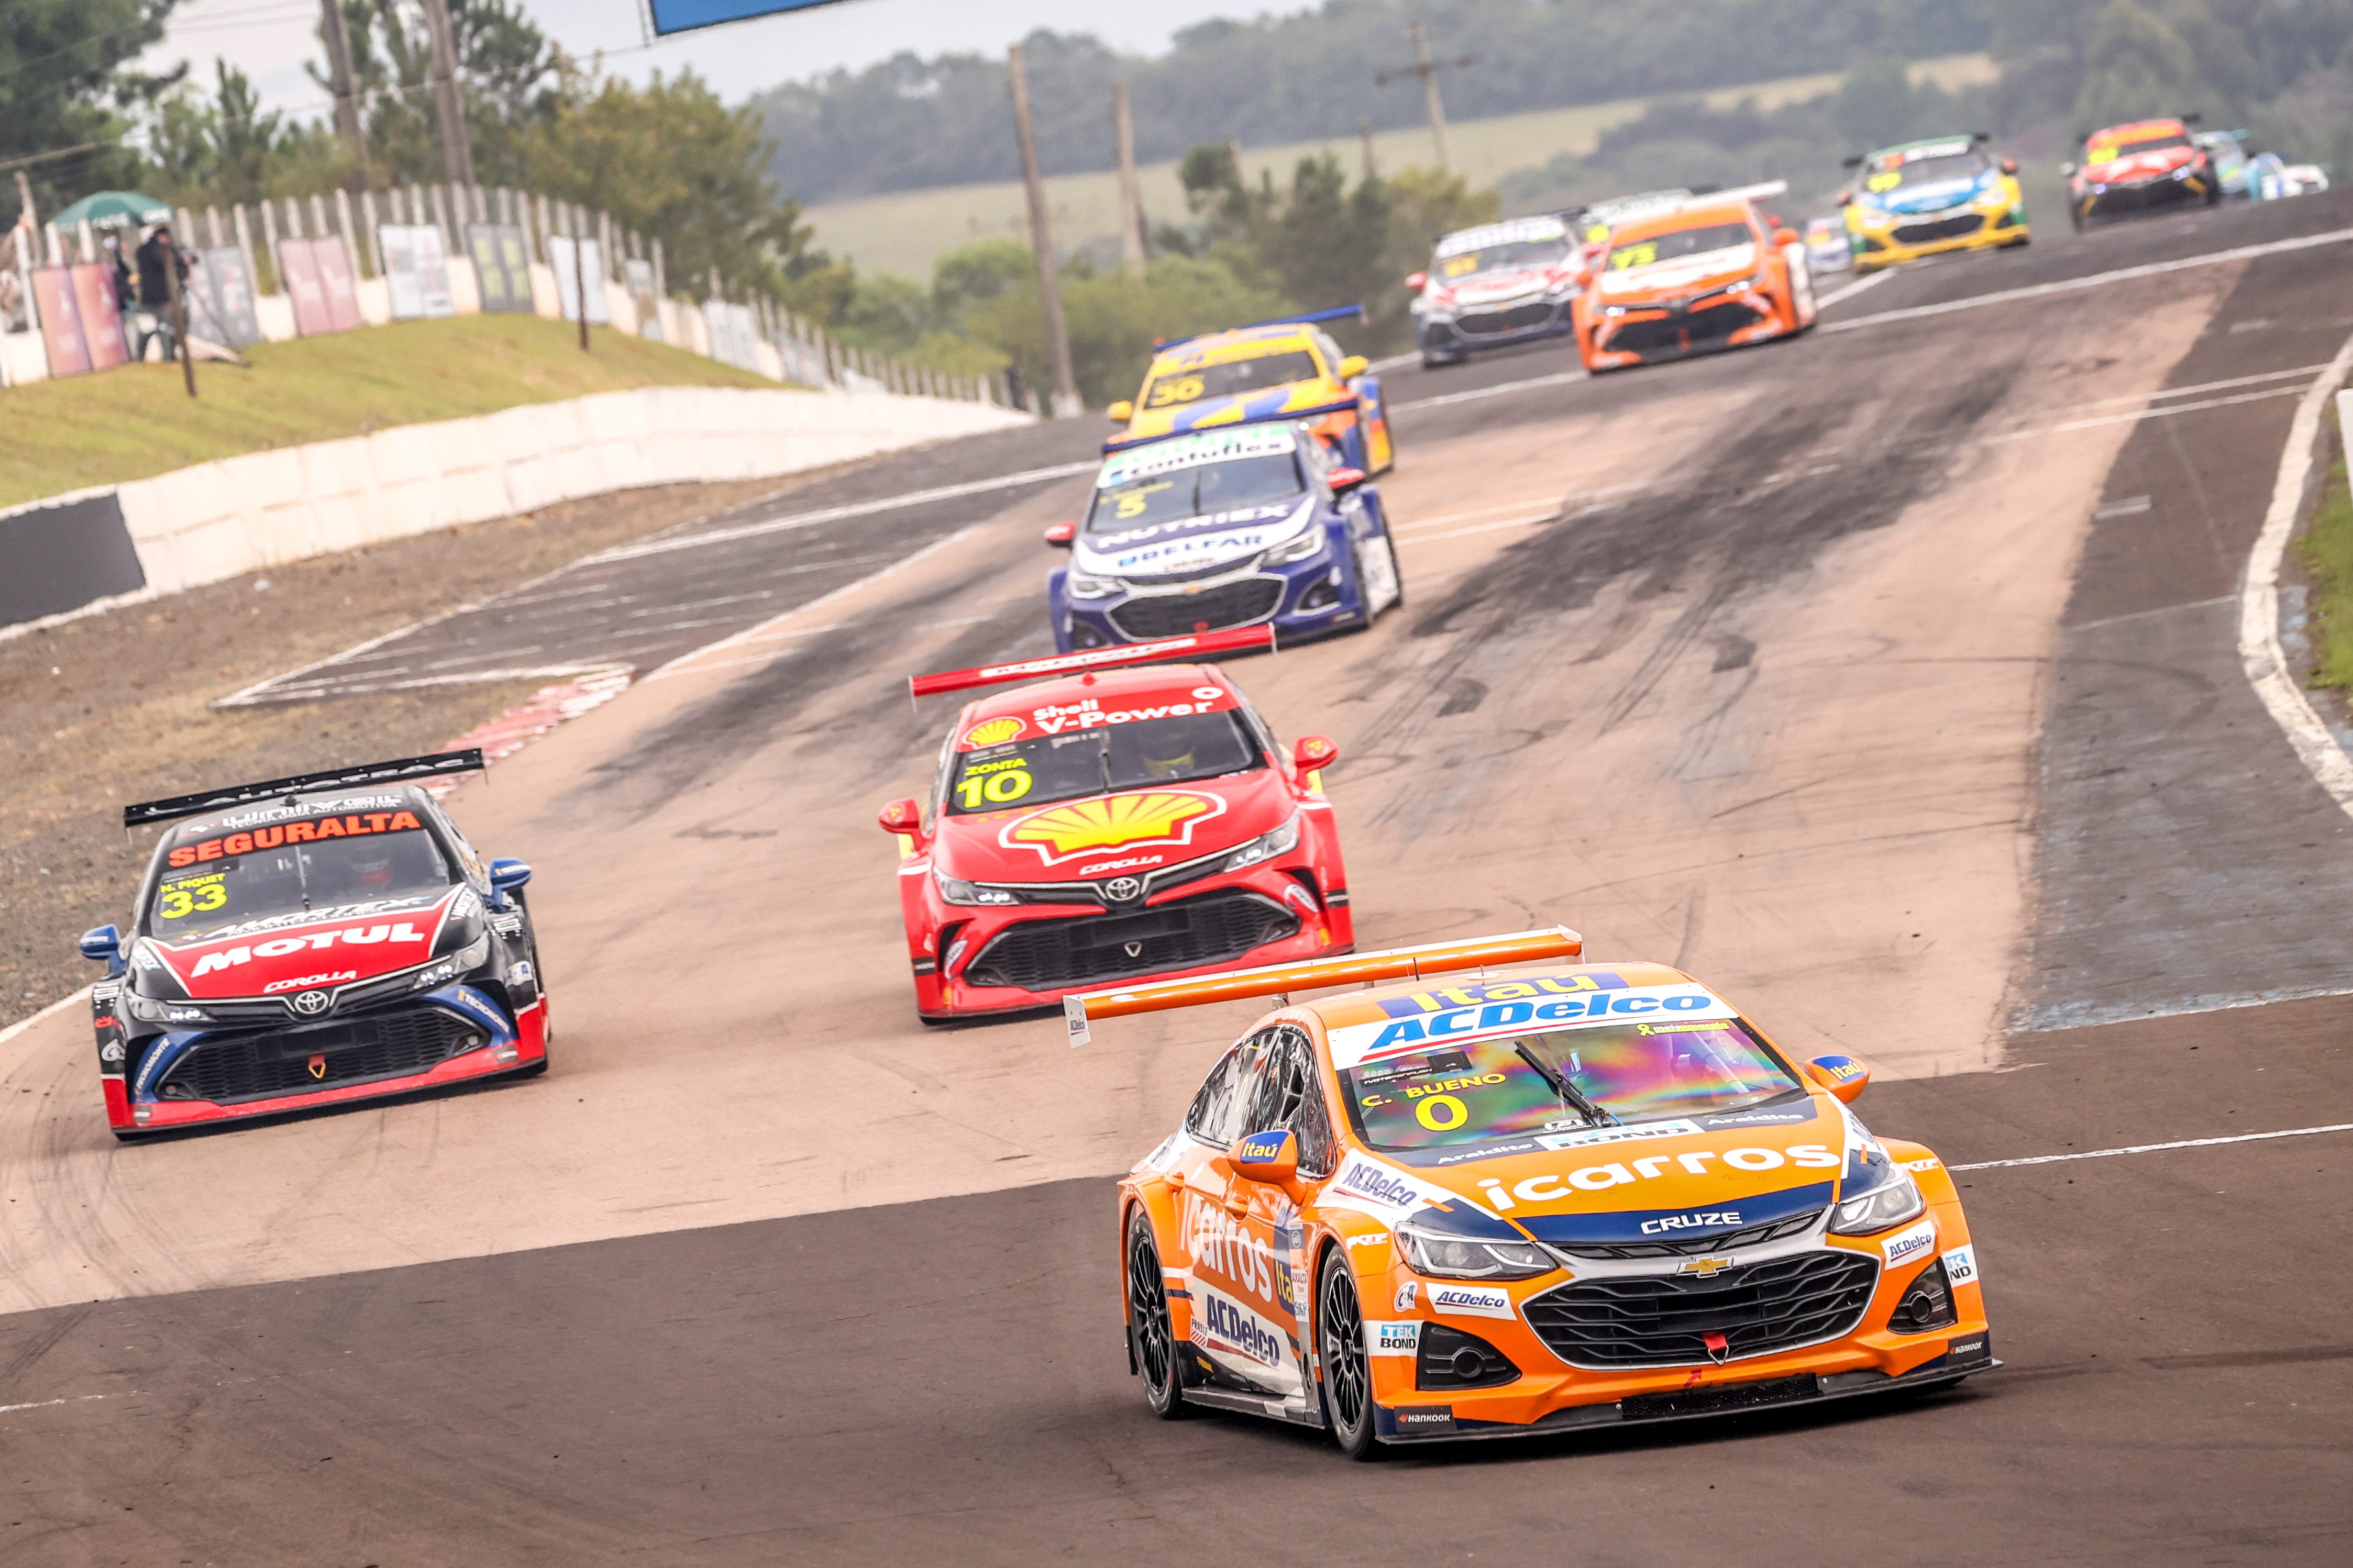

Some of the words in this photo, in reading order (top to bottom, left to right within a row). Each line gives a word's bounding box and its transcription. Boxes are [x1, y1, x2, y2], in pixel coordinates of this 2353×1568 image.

[1033, 698, 1099, 720] Shell
[1036, 701, 1214, 734] V-Power
[965, 757, 1028, 776] ZONTA
[956, 769, 1033, 808] 10
[168, 811, 422, 868] SEGURALTA
[1079, 854, 1163, 875] COROLLA
[160, 883, 176, 893] N.
[178, 872, 226, 889] PIQUET
[160, 883, 228, 919] 33
[190, 922, 425, 978] MOTUL
[262, 970, 357, 994] COROLLA
[1410, 973, 1601, 1011] Itaú
[1367, 993, 1711, 1050] ACDelco
[1829, 1060, 1863, 1080] Itaú
[1361, 1094, 1393, 1107] C.
[1405, 1073, 1507, 1098] BUENO
[1415, 1094, 1469, 1132] 0
[1707, 1112, 1804, 1127] Araldite
[1241, 1141, 1279, 1158] Itaú
[1558, 1127, 1689, 1148] BOND
[1437, 1142, 1535, 1165] Araldite
[1341, 1163, 1417, 1207] ACDelco
[1476, 1144, 1841, 1211] icarros
[1640, 1211, 1743, 1235] CRUZE
[1180, 1189, 1273, 1303] icarros
[1888, 1233, 1932, 1257] ACDelco
[1275, 1260, 1295, 1306] Ita
[1291, 1271, 1308, 1284] AXALTA
[1294, 1300, 1308, 1317] SKF
[1436, 1291, 1506, 1308] ACDelco
[1207, 1293, 1280, 1367] ACDelco
[1384, 1326, 1415, 1337] TEK
[1380, 1338, 1417, 1350] BOND
